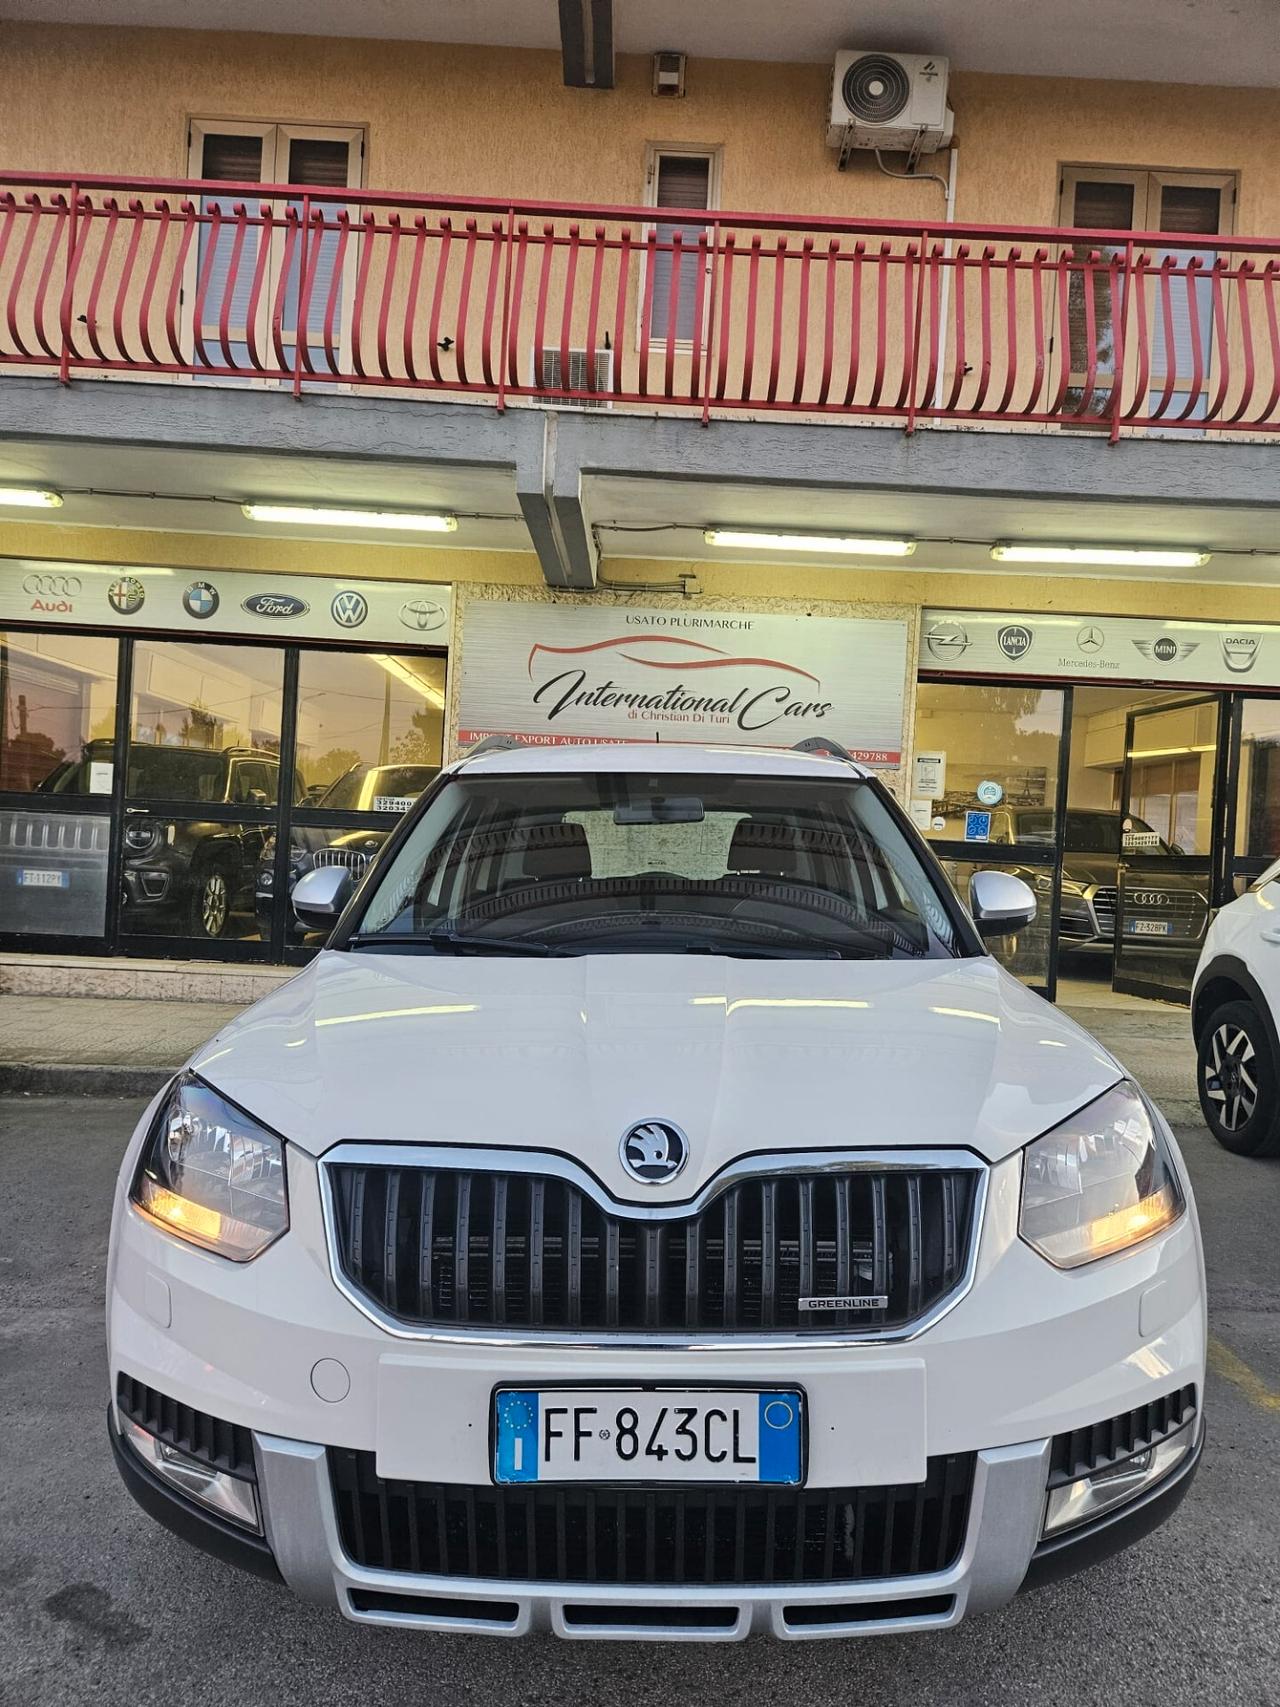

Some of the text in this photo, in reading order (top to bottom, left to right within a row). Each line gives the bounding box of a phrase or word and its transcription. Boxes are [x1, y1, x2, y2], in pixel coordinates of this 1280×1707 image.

[30, 599, 73, 613] Audi
[256, 596, 294, 615] Ford
[625, 615, 755, 630] USATO PLURIMARCHE
[1003, 635, 1027, 647] LANCIA
[1225, 637, 1256, 646] DACIA
[1155, 646, 1176, 655] MINI
[1057, 657, 1120, 670] Mercedes-Benz
[533, 669, 834, 731] International Cars
[627, 709, 730, 724] di Christian Di Turi
[514, 735, 558, 745] EXPORT
[808, 1299, 880, 1309] GREENLINE
